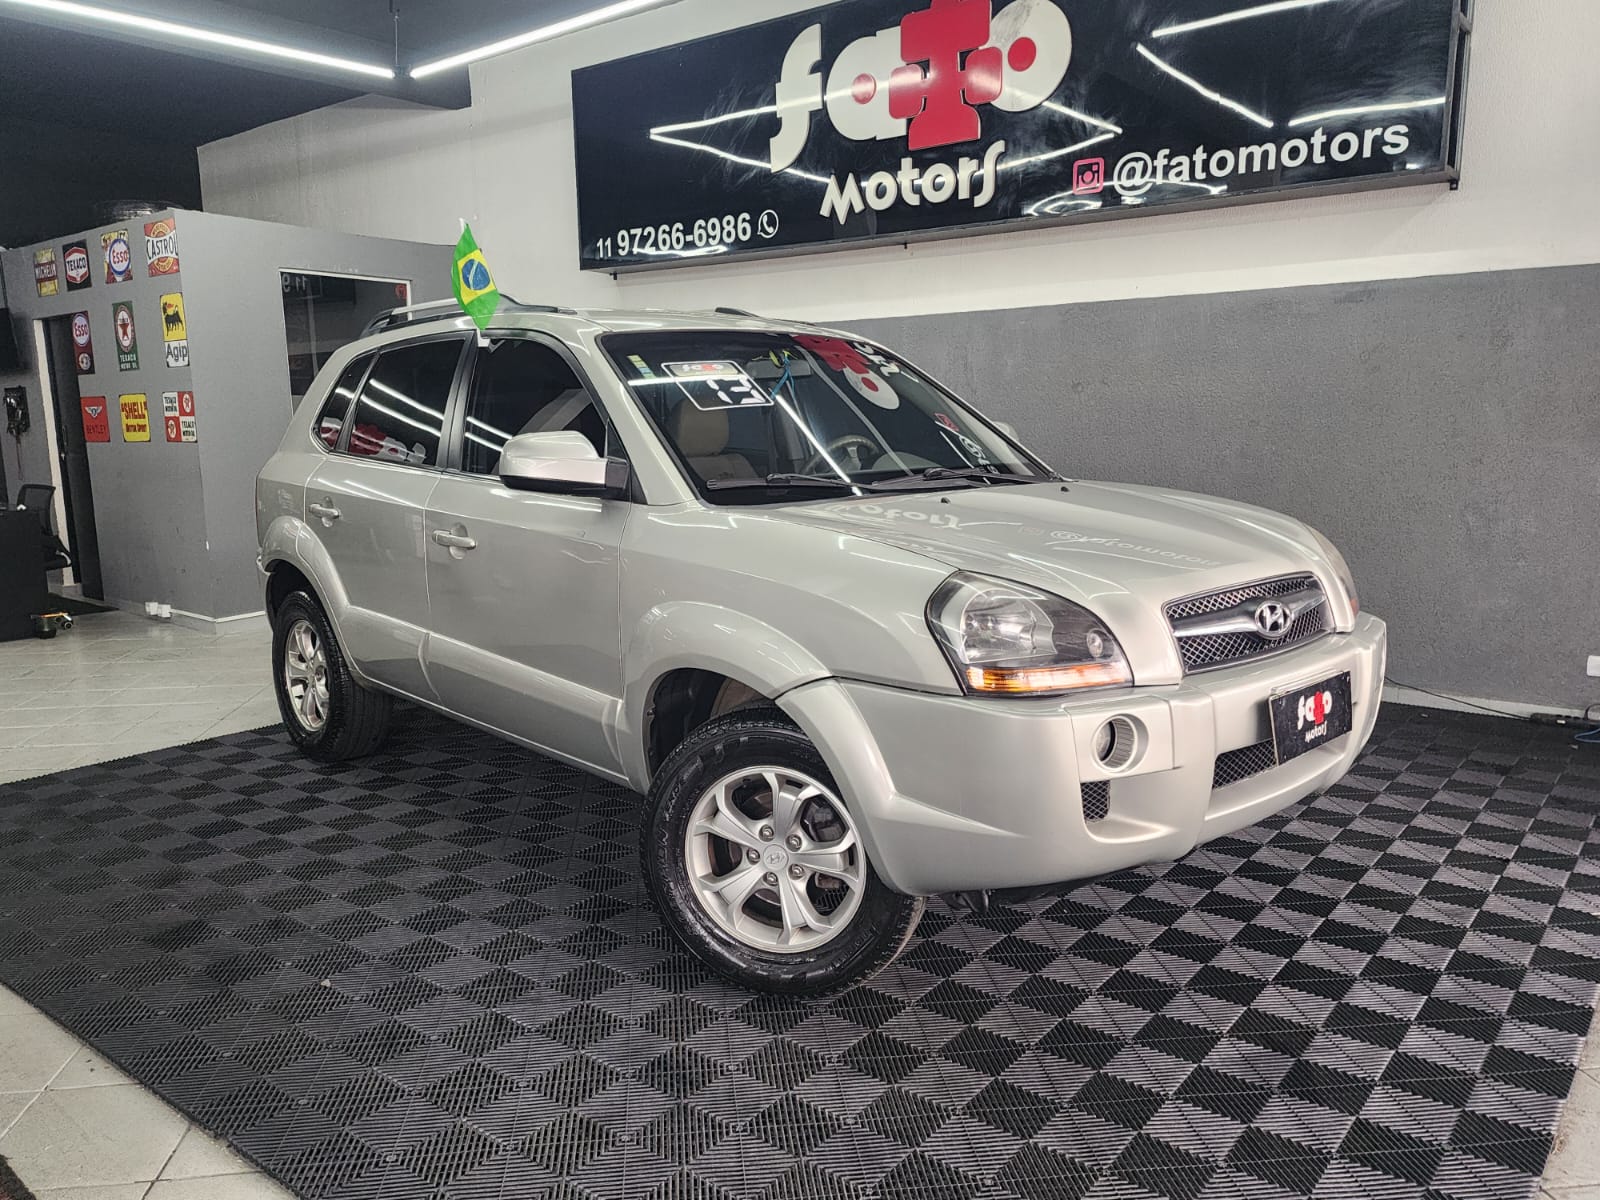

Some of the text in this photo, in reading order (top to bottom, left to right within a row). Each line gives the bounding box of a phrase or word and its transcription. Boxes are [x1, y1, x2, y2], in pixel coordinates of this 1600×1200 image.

[1112, 123, 1410, 197] @fatomotors
[147, 233, 178, 260] CASTROL
[597, 212, 751, 258] 11 97266-6986
[66, 256, 86, 270] TEXACO
[166, 343, 188, 362] Agip
